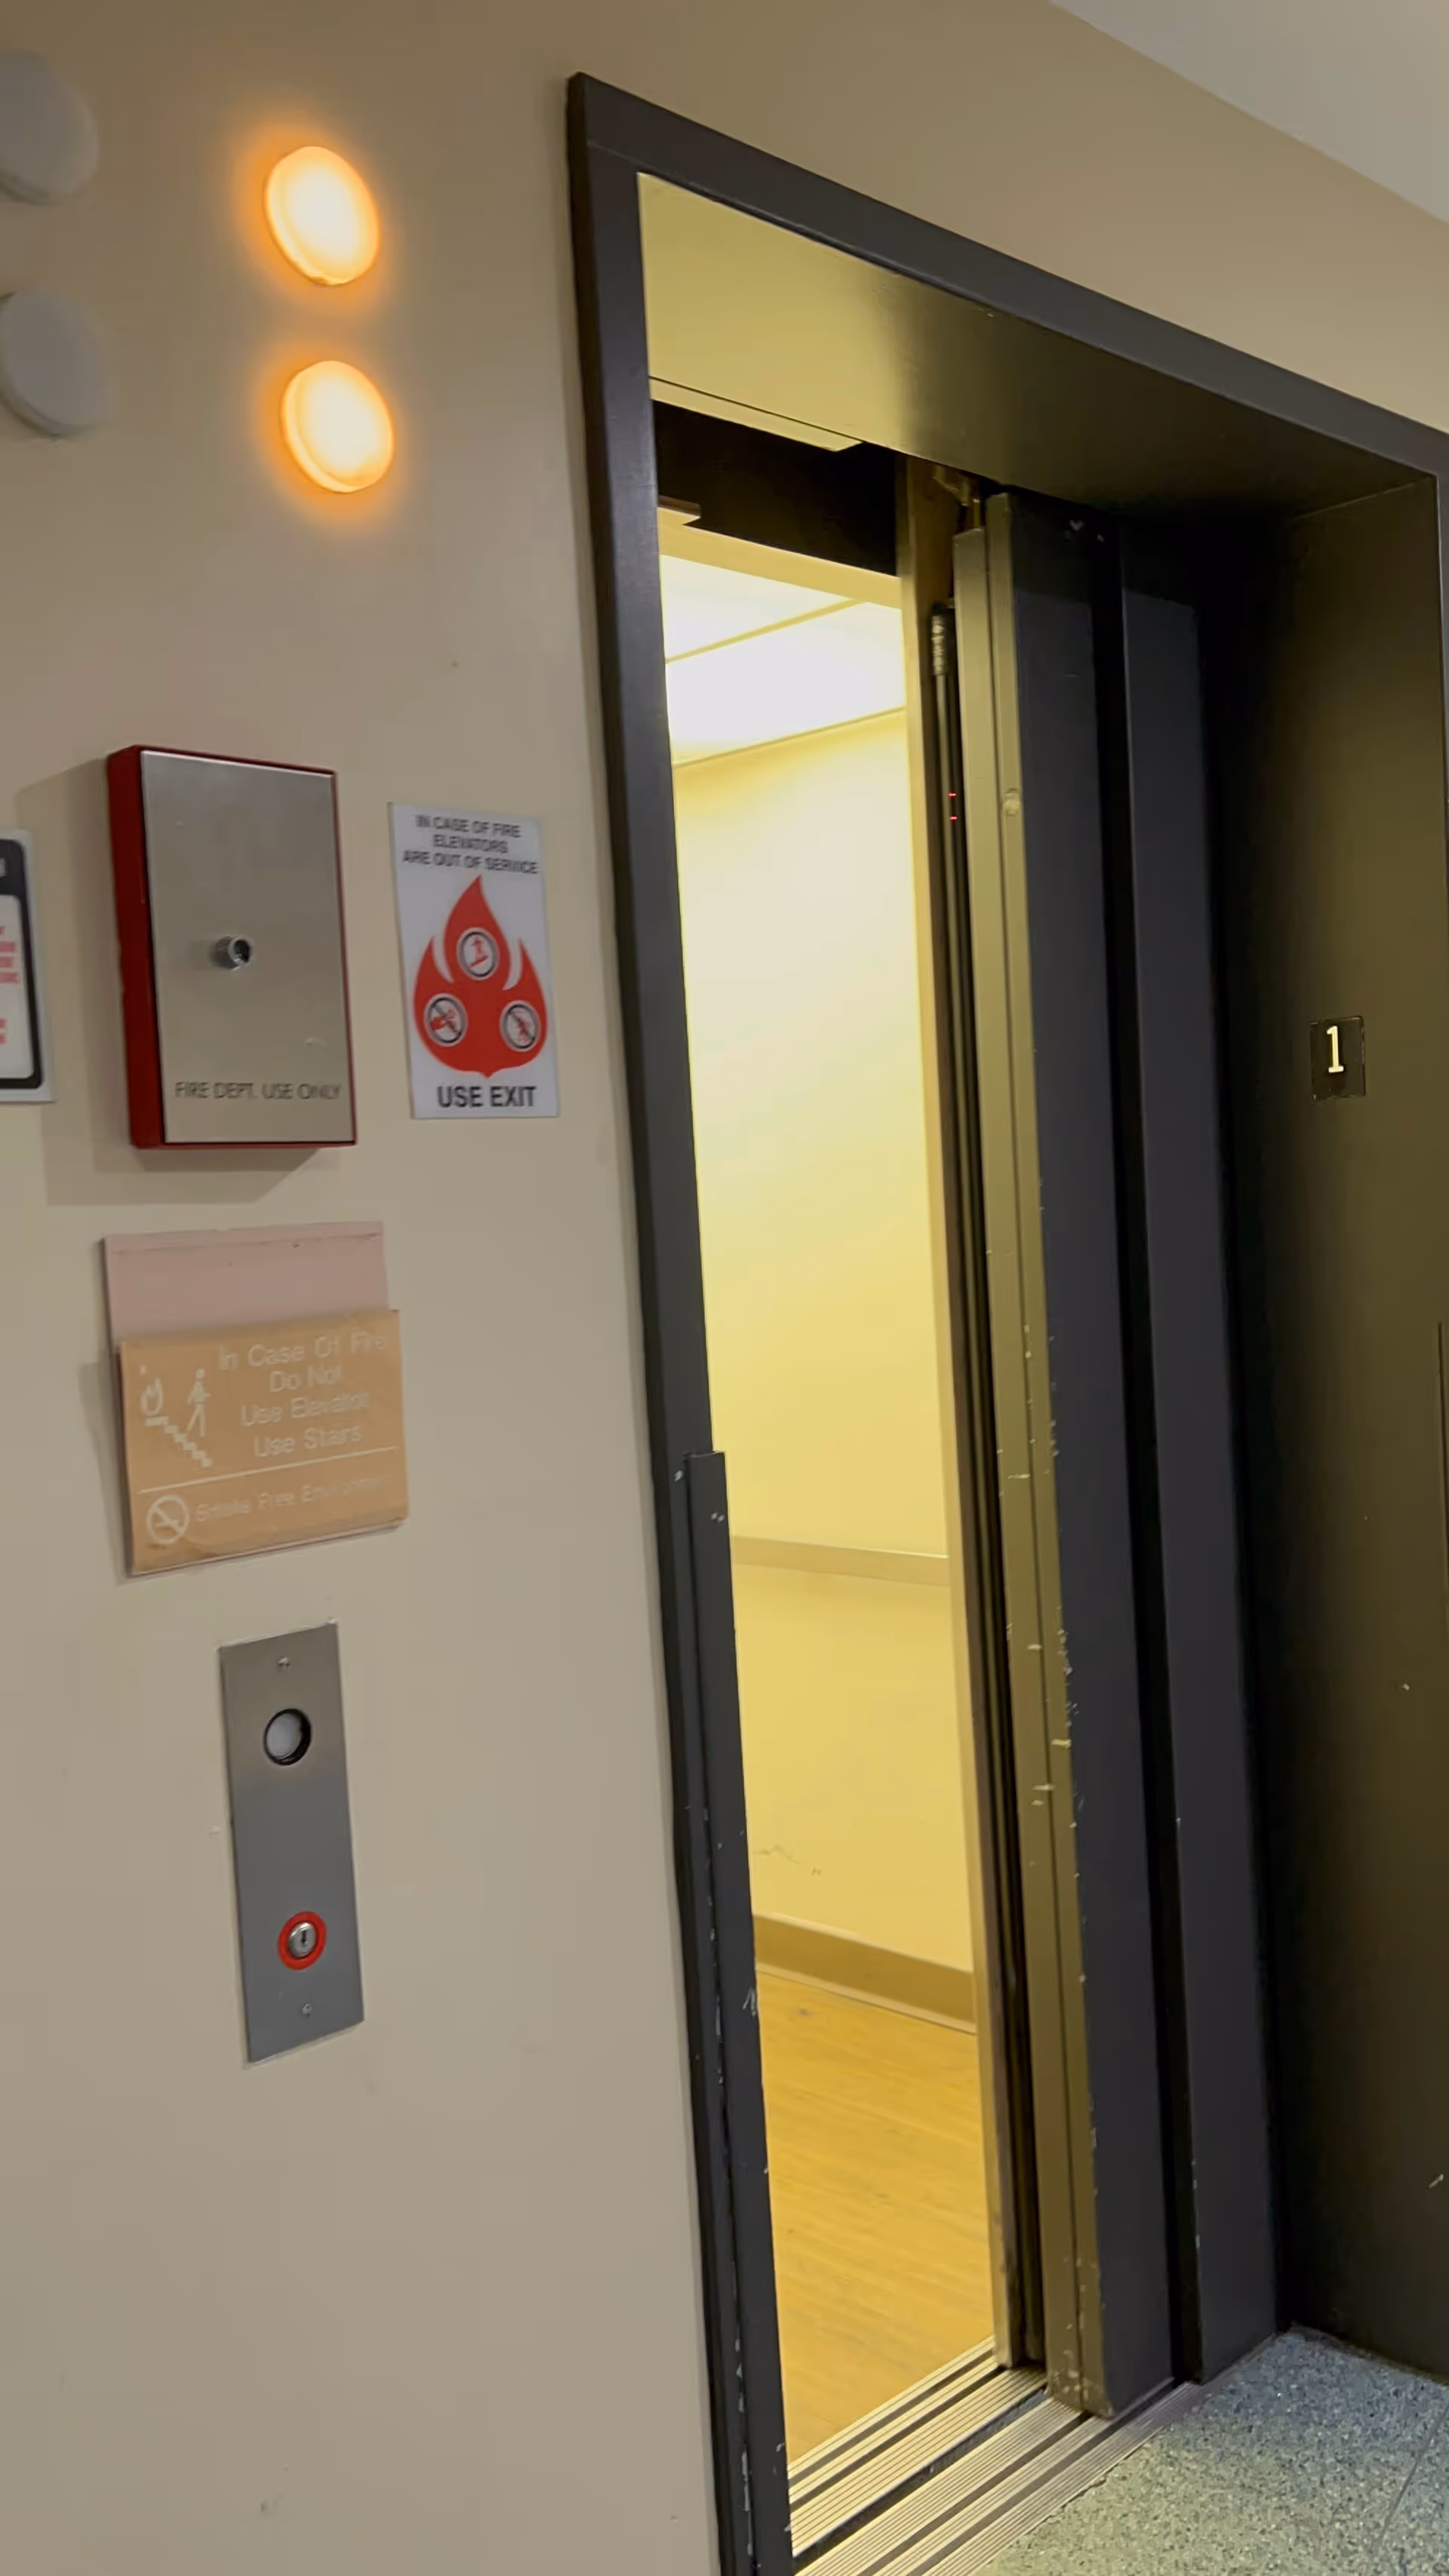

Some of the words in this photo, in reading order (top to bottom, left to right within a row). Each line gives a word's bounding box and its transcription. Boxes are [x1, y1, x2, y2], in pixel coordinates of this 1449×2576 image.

[416, 815, 431, 828] IN
[432, 817, 469, 833] CASE
[471, 820, 489, 833] OF
[492, 823, 521, 838] FIRE
[433, 834, 509, 854] ELEVATORS
[402, 850, 430, 865] ARE
[432, 852, 461, 866] OUT
[463, 855, 483, 868] OF
[485, 857, 538, 874] SERVICE
[1327, 1026, 1344, 1073] 1
[174, 1082, 209, 1099] FIRE
[261, 1083, 293, 1100] USE
[297, 1083, 342, 1100] ONLY
[437, 1085, 483, 1108] USE
[490, 1085, 537, 1107] EXIT
[217, 1343, 239, 1371] In
[248, 1343, 305, 1368] Case
[314, 1335, 340, 1359] Of
[349, 1330, 387, 1354] Fire
[269, 1370, 301, 1393] Do
[307, 1363, 342, 1387] Not
[241, 1403, 283, 1426] Use
[290, 1391, 370, 1419] Elevator
[254, 1434, 296, 1457] Use
[303, 1425, 362, 1450] Stairs
